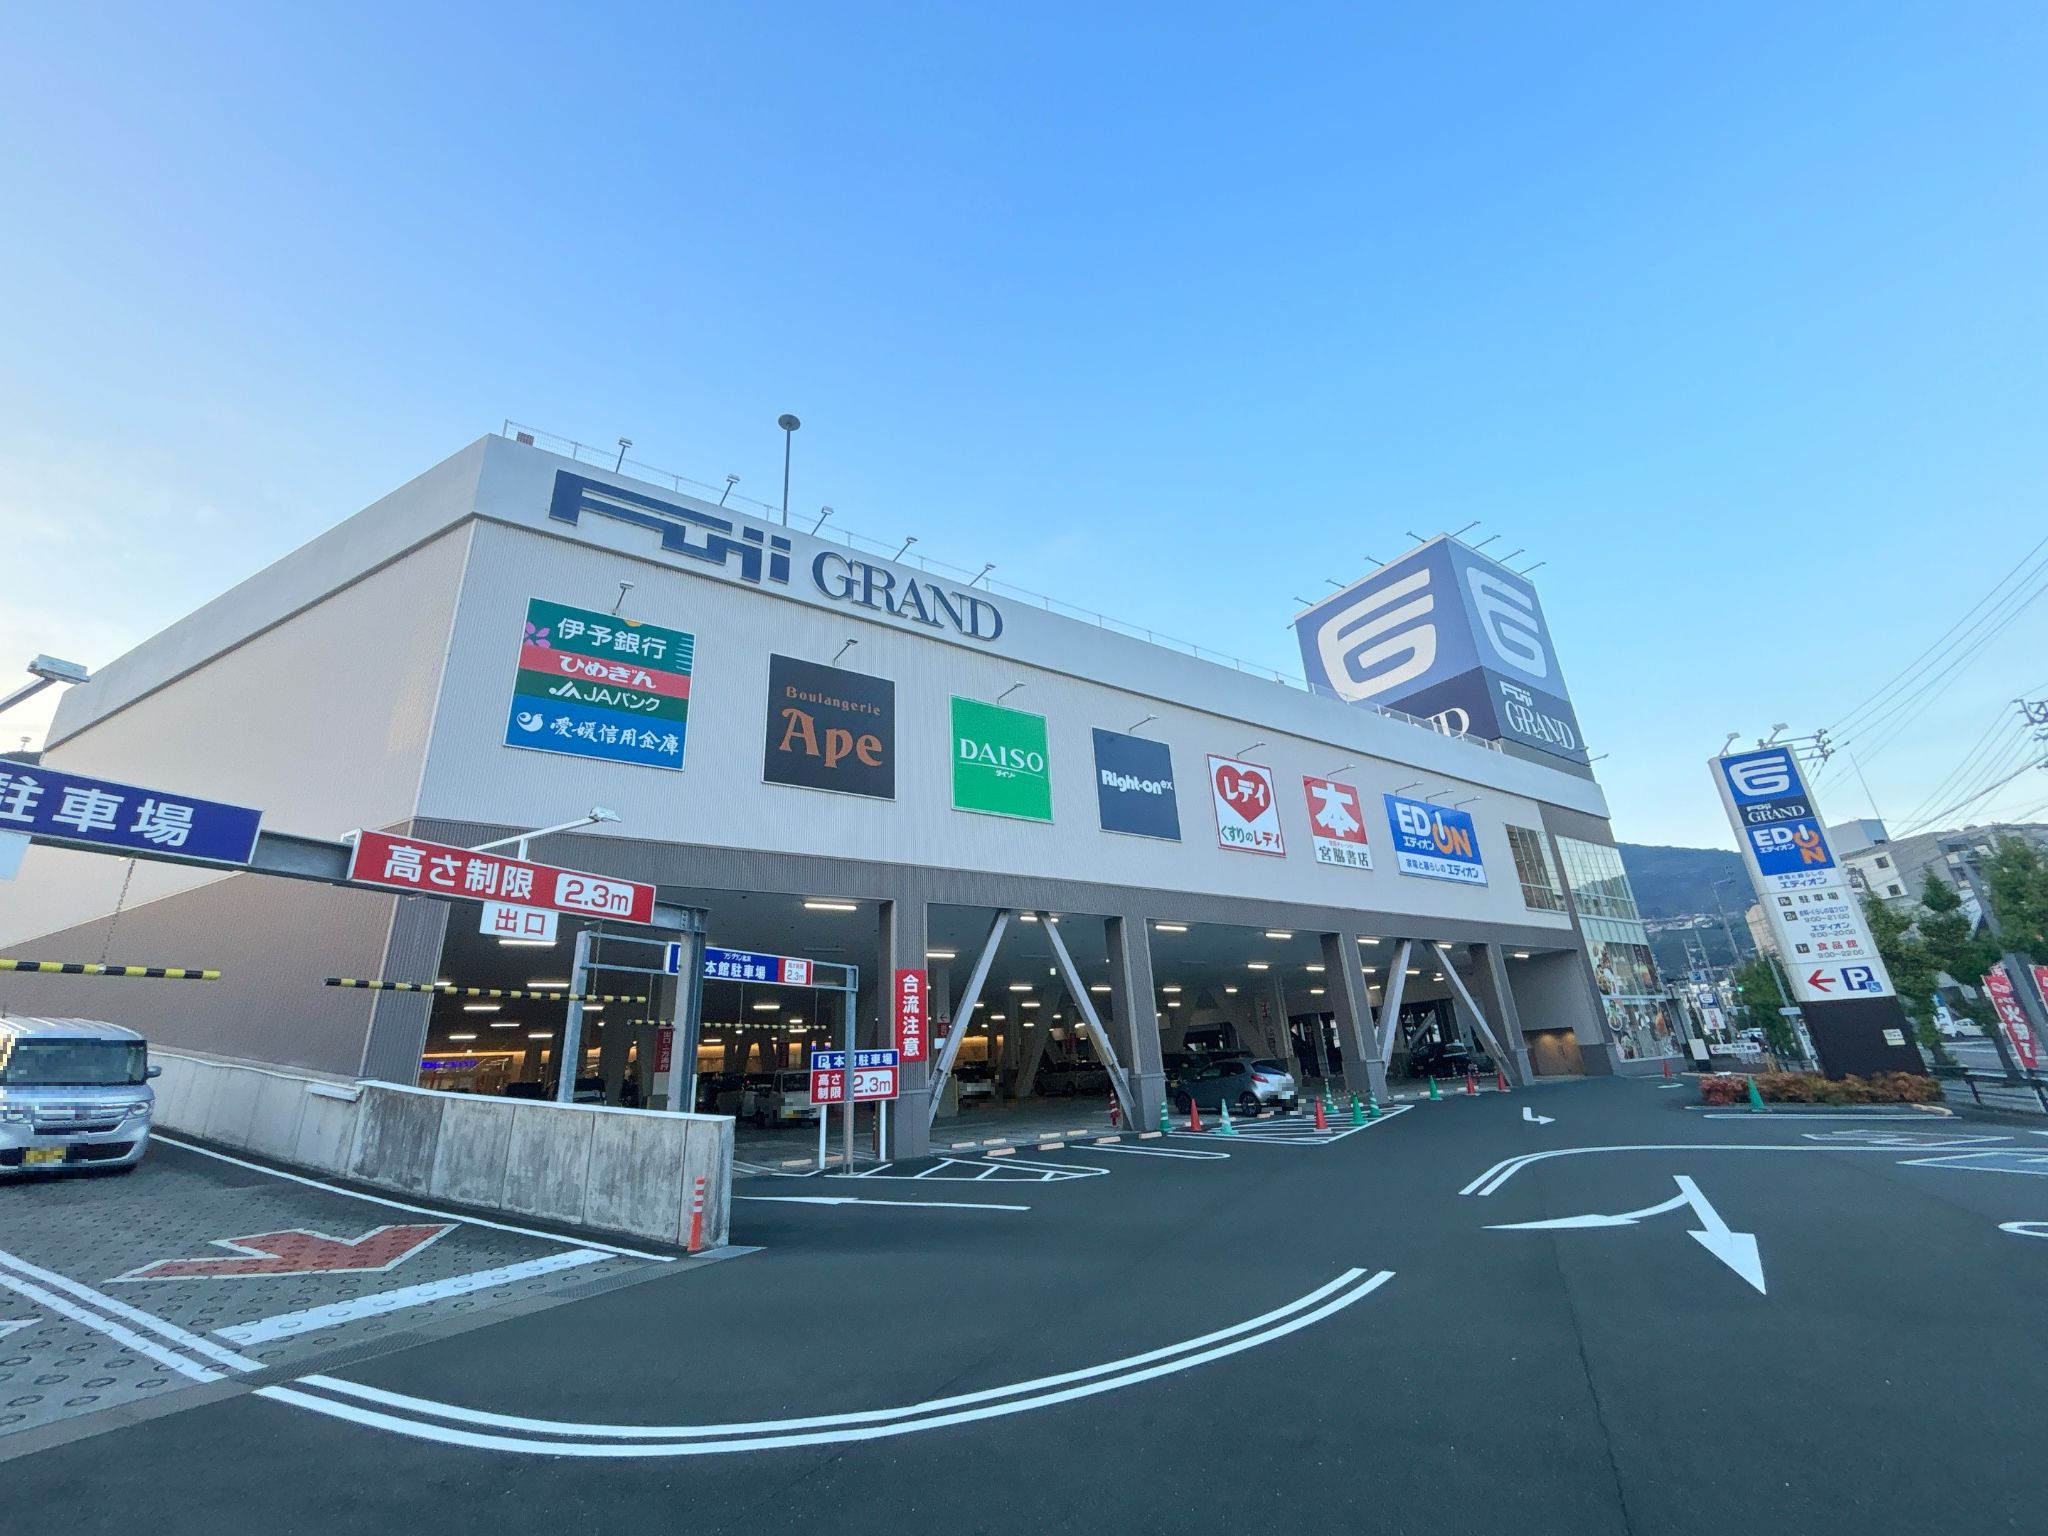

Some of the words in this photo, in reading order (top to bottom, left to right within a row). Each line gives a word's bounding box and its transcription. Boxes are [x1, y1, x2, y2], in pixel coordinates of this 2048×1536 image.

[811, 551, 1004, 642] GRAND
[557, 617, 668, 660] 伊予銀行
[560, 655, 656, 689] ひめぎん
[583, 686, 660, 712] JAバンク
[785, 685, 882, 716] Boulangerie
[550, 717, 679, 756] 愛媛信用金庫
[779, 707, 883, 768] Ape
[1505, 700, 1575, 750] GRAND
[959, 738, 1044, 772] DAISO
[1101, 769, 1162, 796] Right-on
[1223, 776, 1265, 807] レディ
[1311, 783, 1360, 837] 本
[1748, 805, 1805, 823] GRAND
[1220, 825, 1280, 849] くすりのレディ
[1394, 802, 1472, 858] EDION
[1402, 836, 1435, 851] エディオン
[1752, 824, 1827, 864] EDION
[1319, 845, 1369, 867] 宮脇書店
[384, 844, 535, 901] 高さ制限
[564, 879, 630, 914] 2.3m
[1780, 878, 1828, 889] エディオン
[494, 907, 547, 936] 出口
[1811, 922, 1850, 931] エディオン
[705, 961, 766, 980] 本館駐車場
[1846, 968, 1869, 990] P
[902, 974, 920, 1057] 合流注意
[833, 1053, 893, 1067] 本駐車場
[818, 1073, 842, 1087] 高さ
